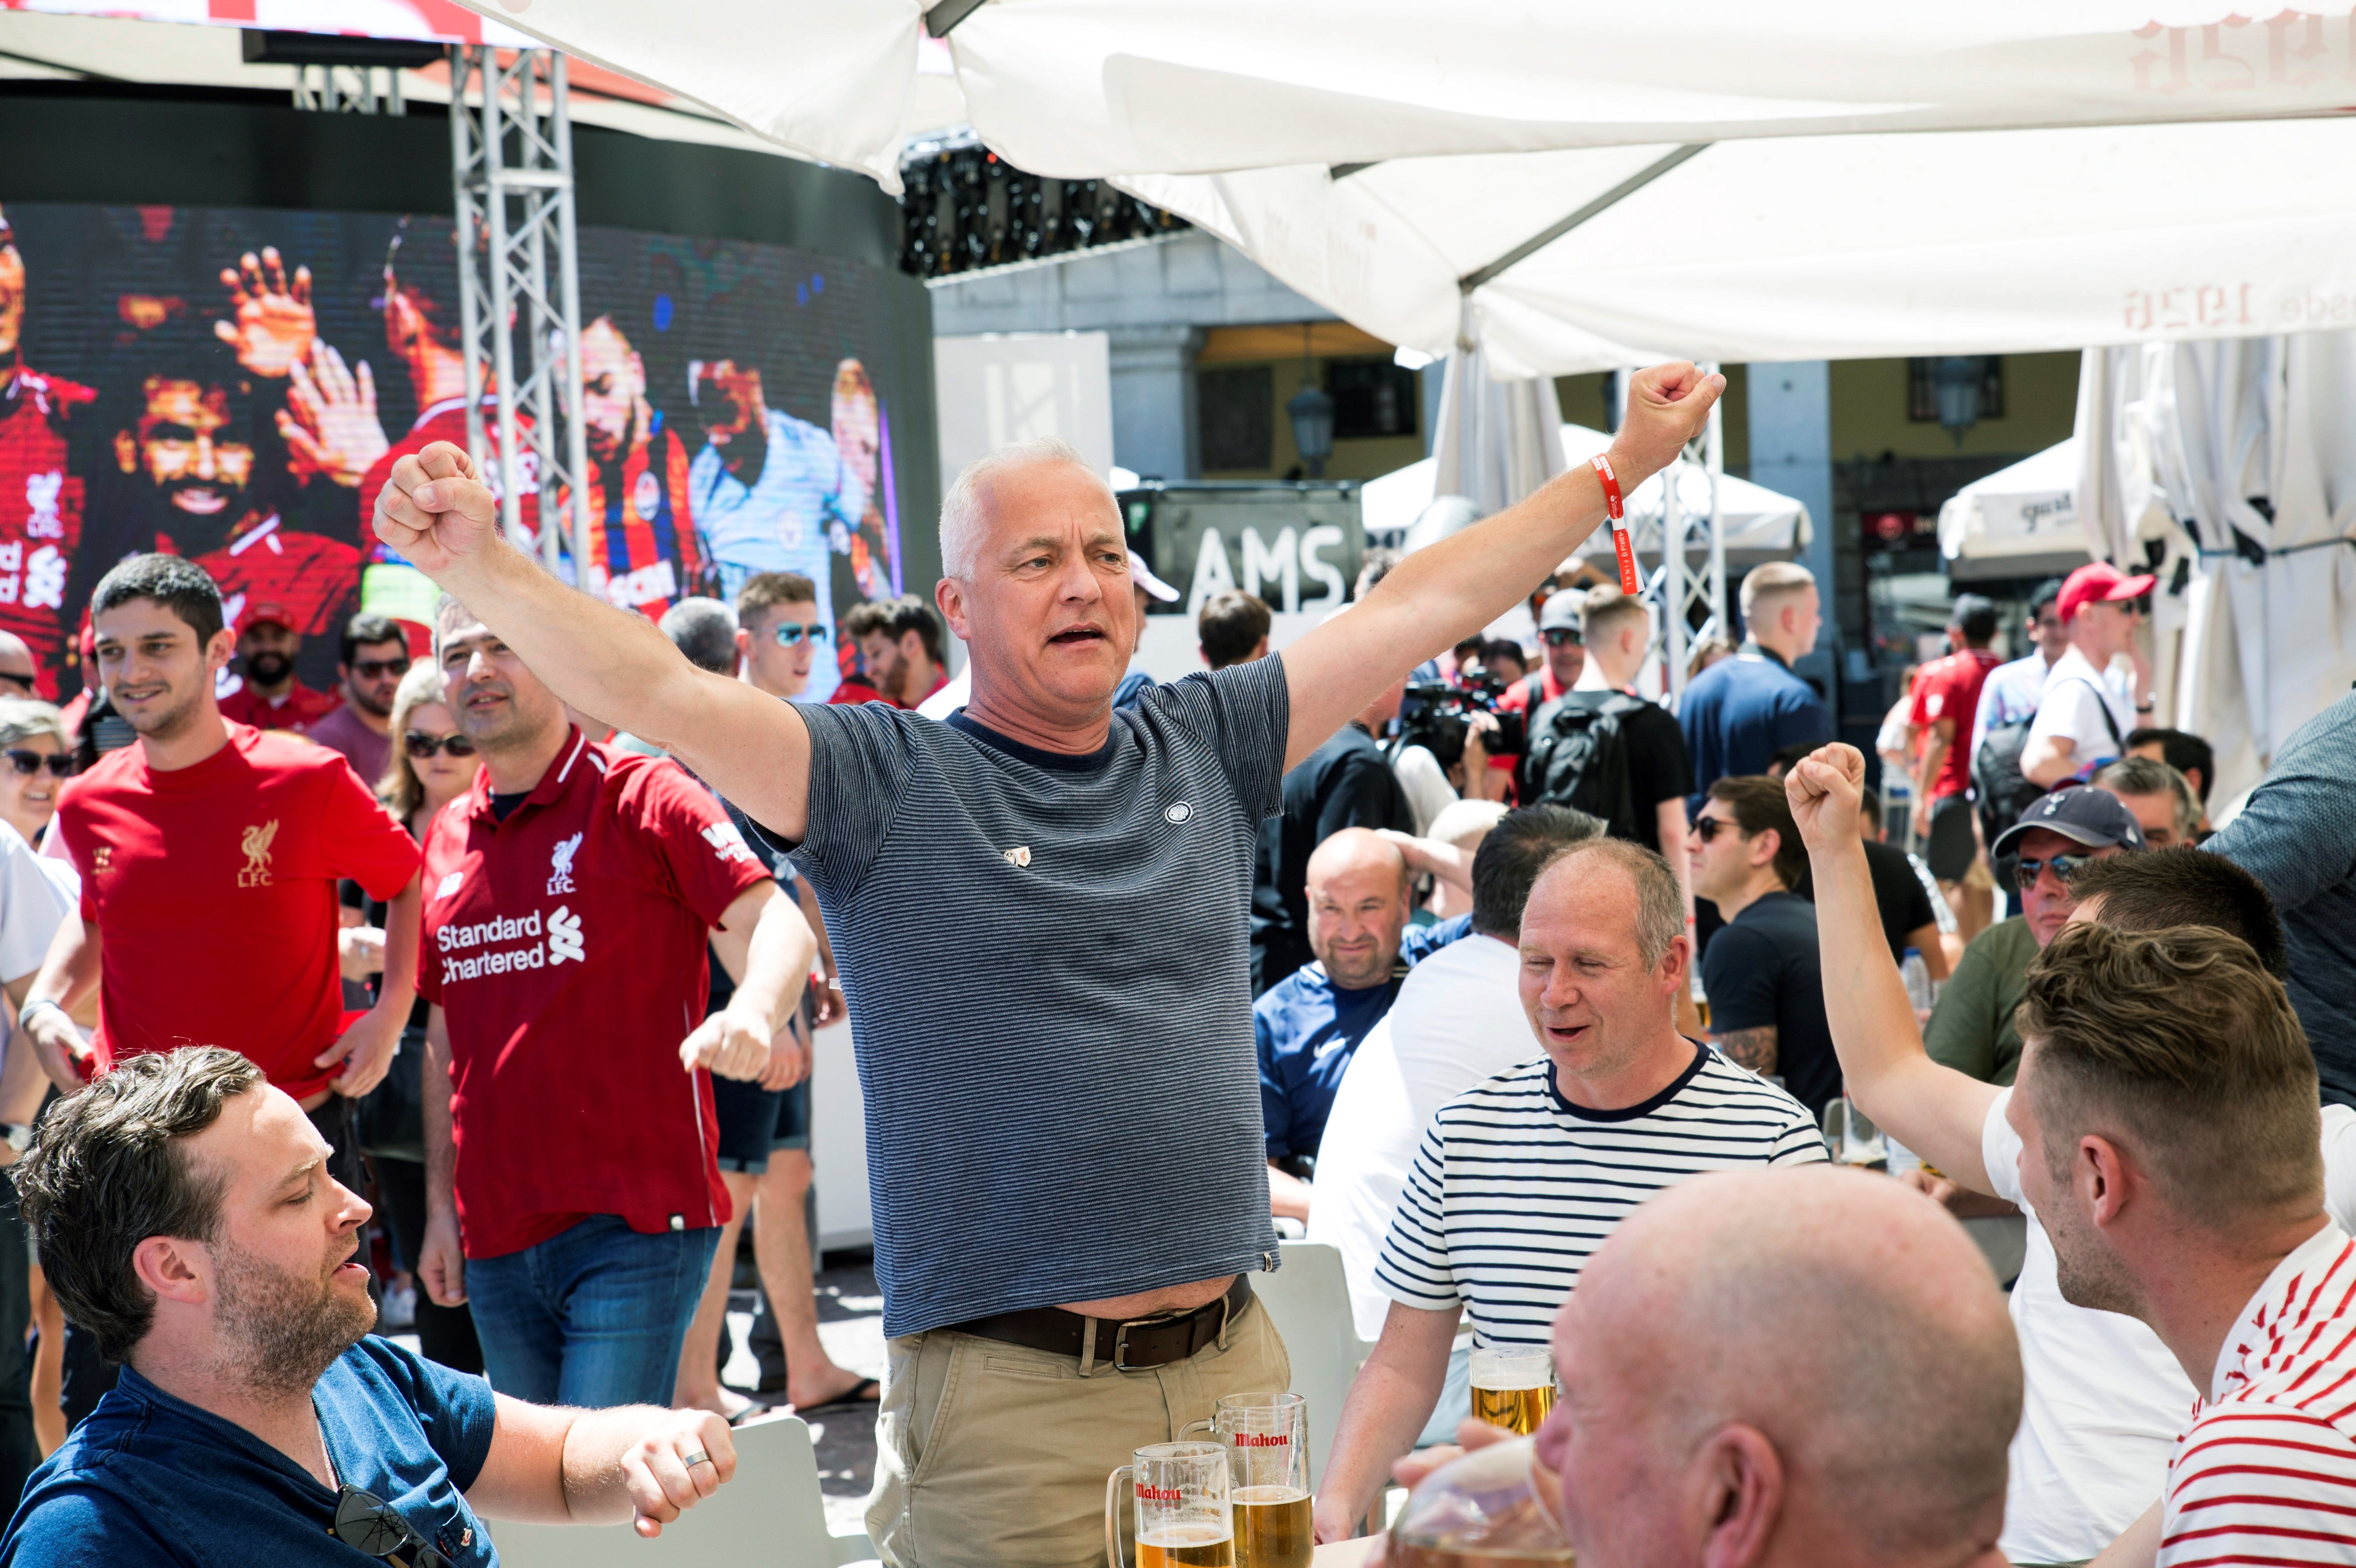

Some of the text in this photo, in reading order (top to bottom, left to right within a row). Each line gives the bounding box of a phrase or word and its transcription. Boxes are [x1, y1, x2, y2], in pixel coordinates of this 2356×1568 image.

[1186, 525, 1346, 615] AMS
[1623, 559, 1632, 587] FINAL
[437, 908, 542, 952] Standard
[1235, 1432, 1288, 1447] Mahou
[1136, 1483, 1182, 1500] Mahou
